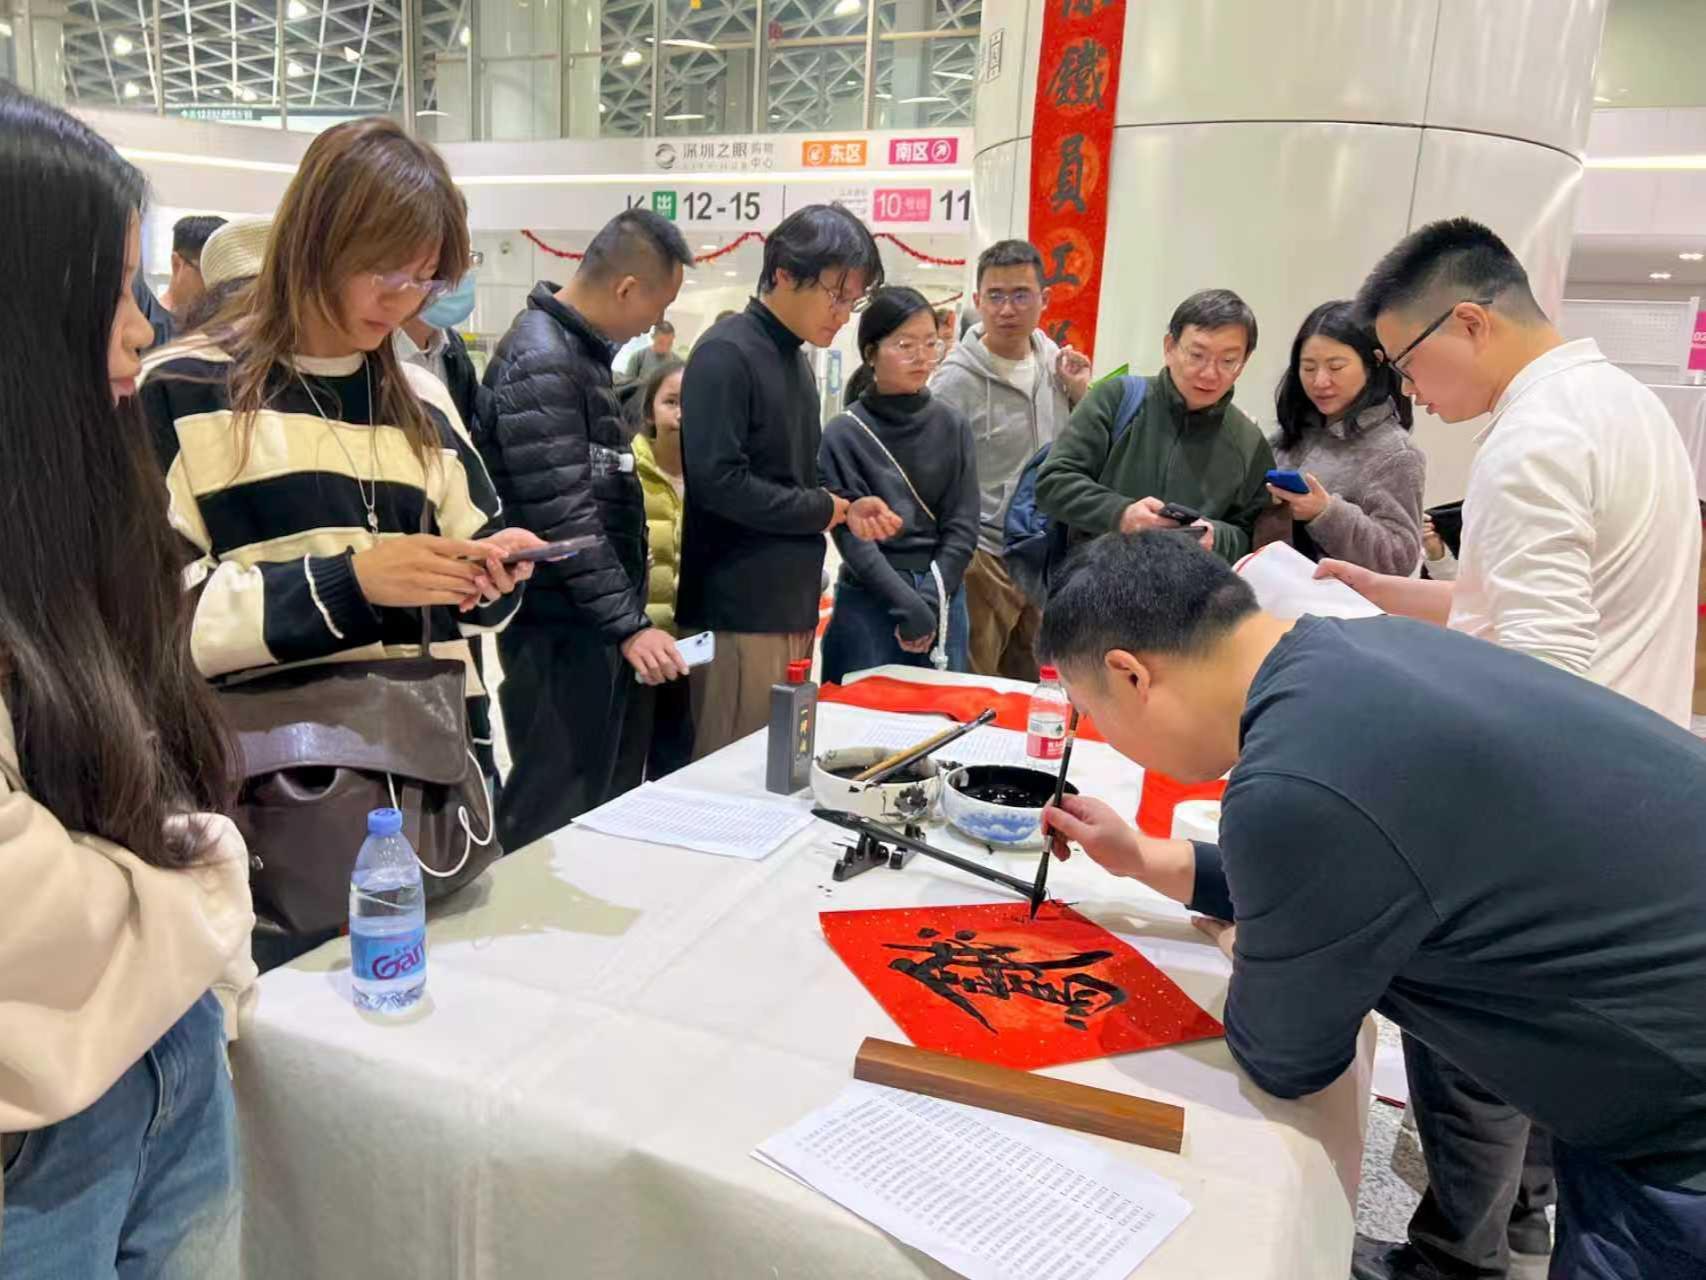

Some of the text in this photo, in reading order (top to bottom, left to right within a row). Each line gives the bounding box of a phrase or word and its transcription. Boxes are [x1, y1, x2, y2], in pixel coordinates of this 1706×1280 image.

[682, 142, 748, 160] 深圳之眼
[829, 143, 862, 163] 东区
[895, 141, 929, 162] 南区
[683, 191, 761, 221] 12-15
